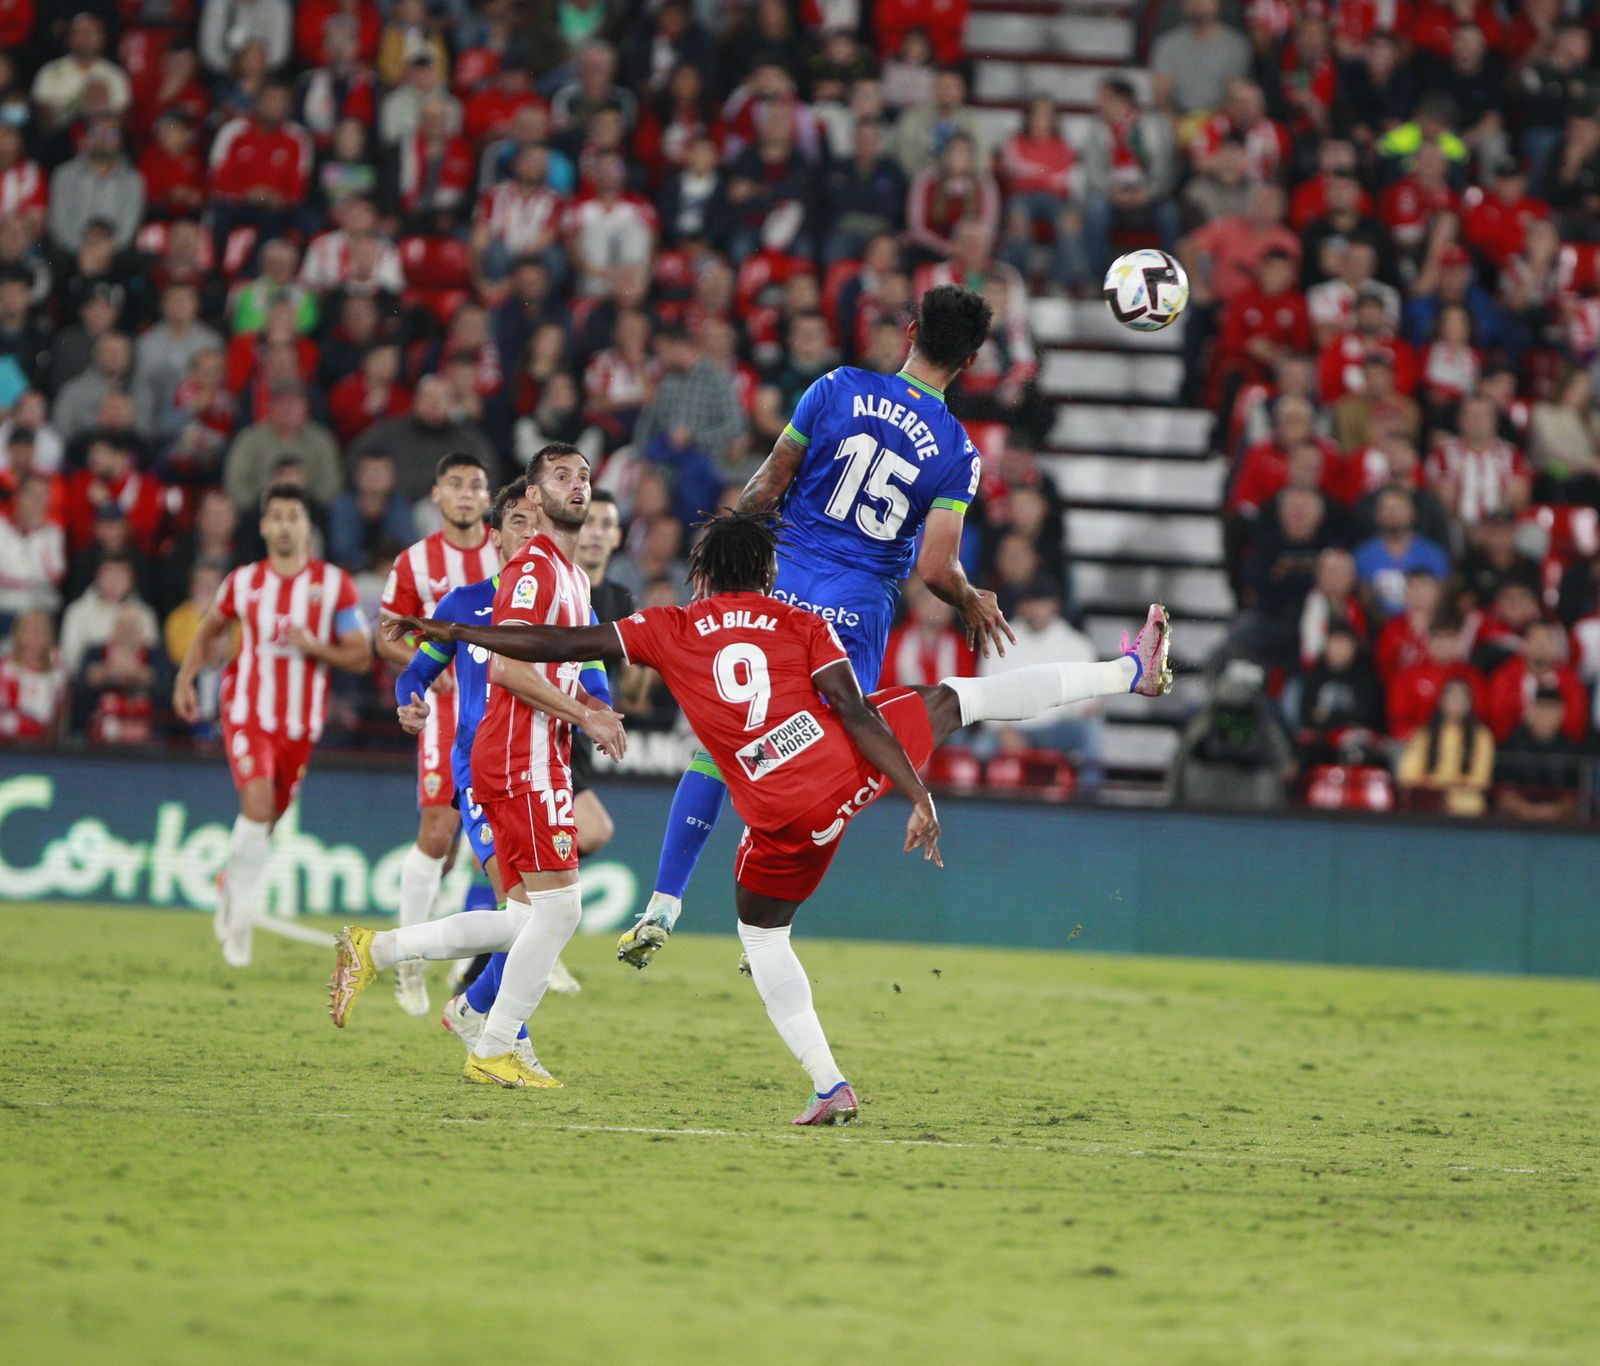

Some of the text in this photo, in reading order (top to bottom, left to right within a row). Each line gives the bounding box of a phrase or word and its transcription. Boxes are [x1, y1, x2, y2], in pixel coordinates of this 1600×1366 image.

[853, 394, 939, 461] ALDERETE
[824, 432, 920, 541] 15
[694, 610, 778, 637] EL BILAL
[712, 642, 771, 731] 9
[770, 714, 811, 746] POWER
[777, 723, 820, 757] HORSE
[540, 788, 574, 826] 12
